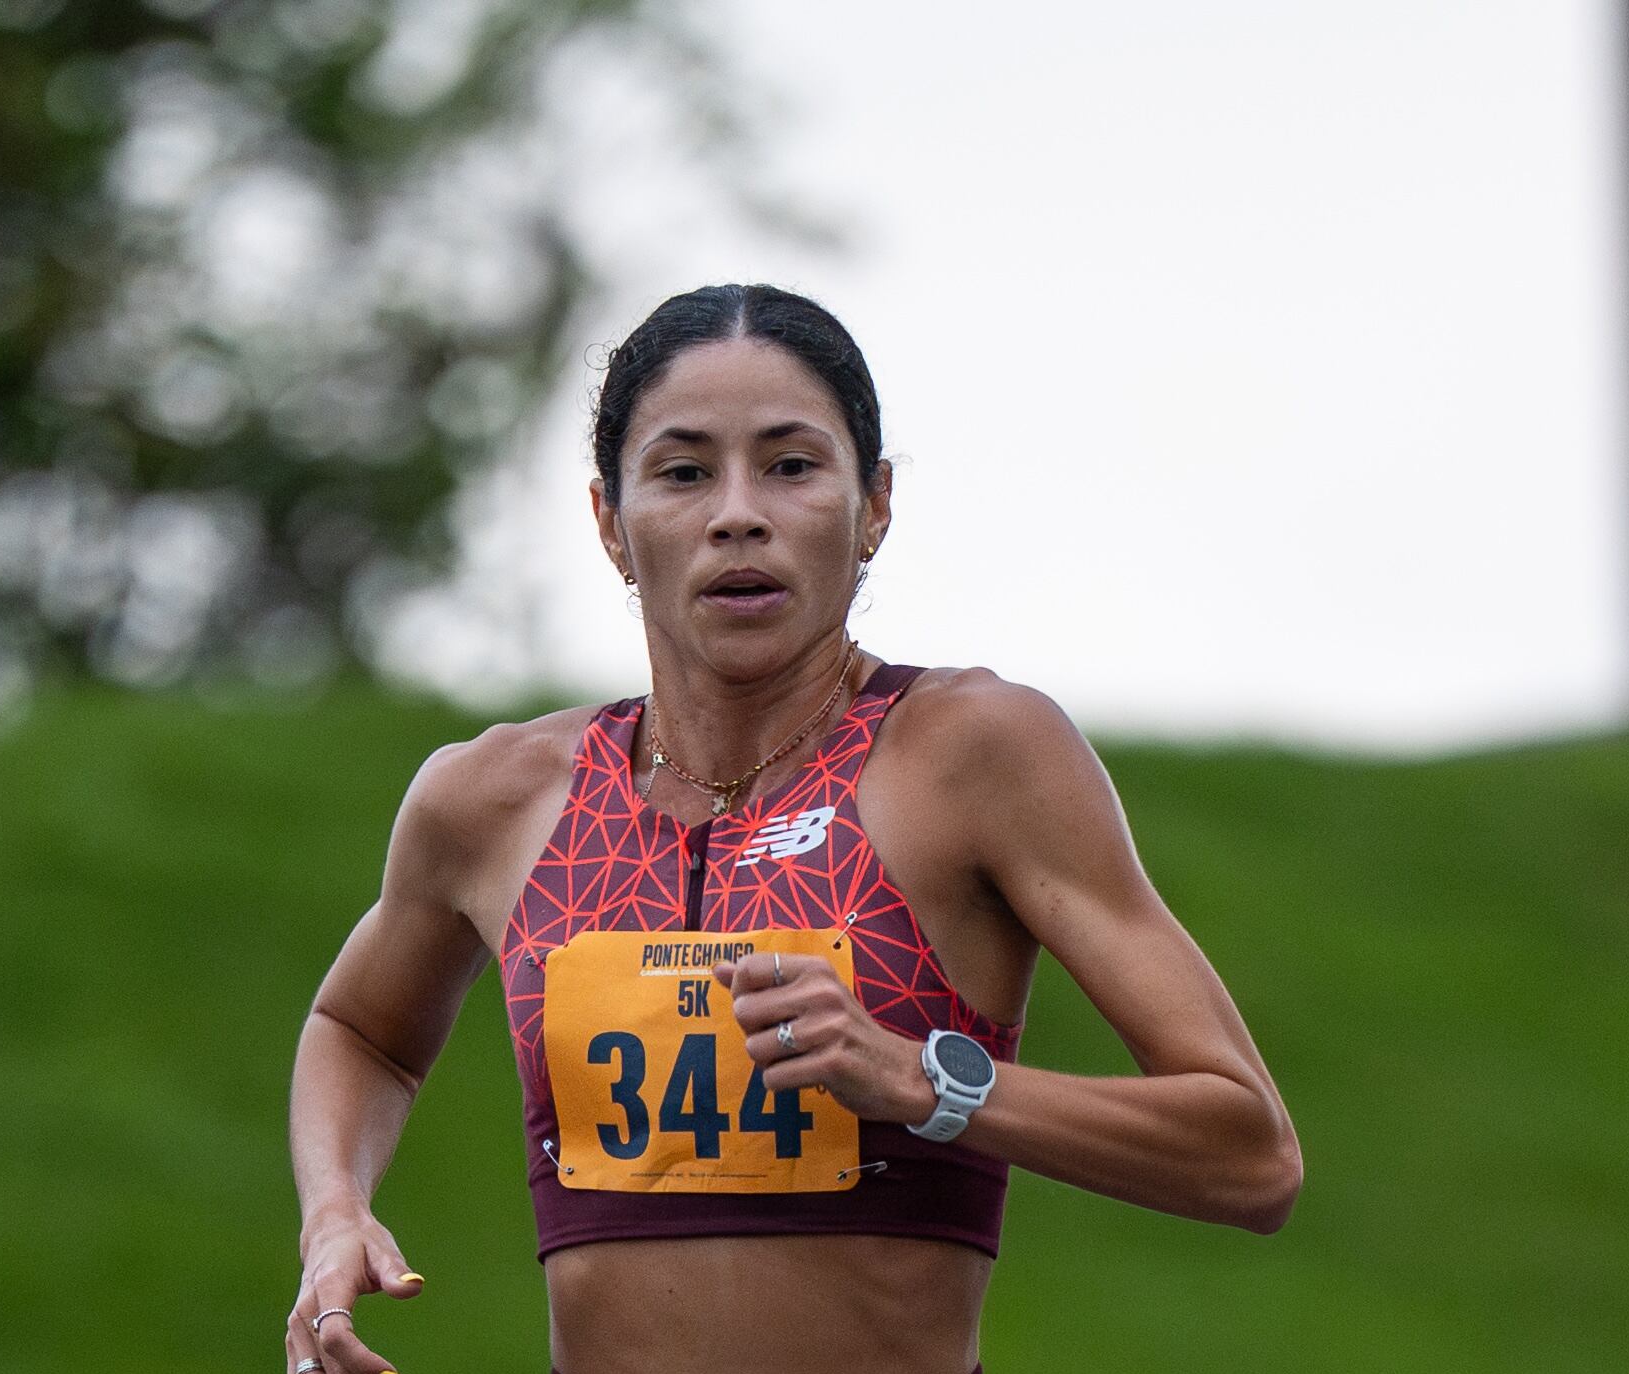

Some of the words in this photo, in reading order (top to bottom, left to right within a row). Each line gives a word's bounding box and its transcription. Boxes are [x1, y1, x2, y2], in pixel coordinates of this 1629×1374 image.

[642, 943, 691, 967] PONTE
[678, 980, 710, 1018] 5K
[587, 1031, 814, 1160] 344
